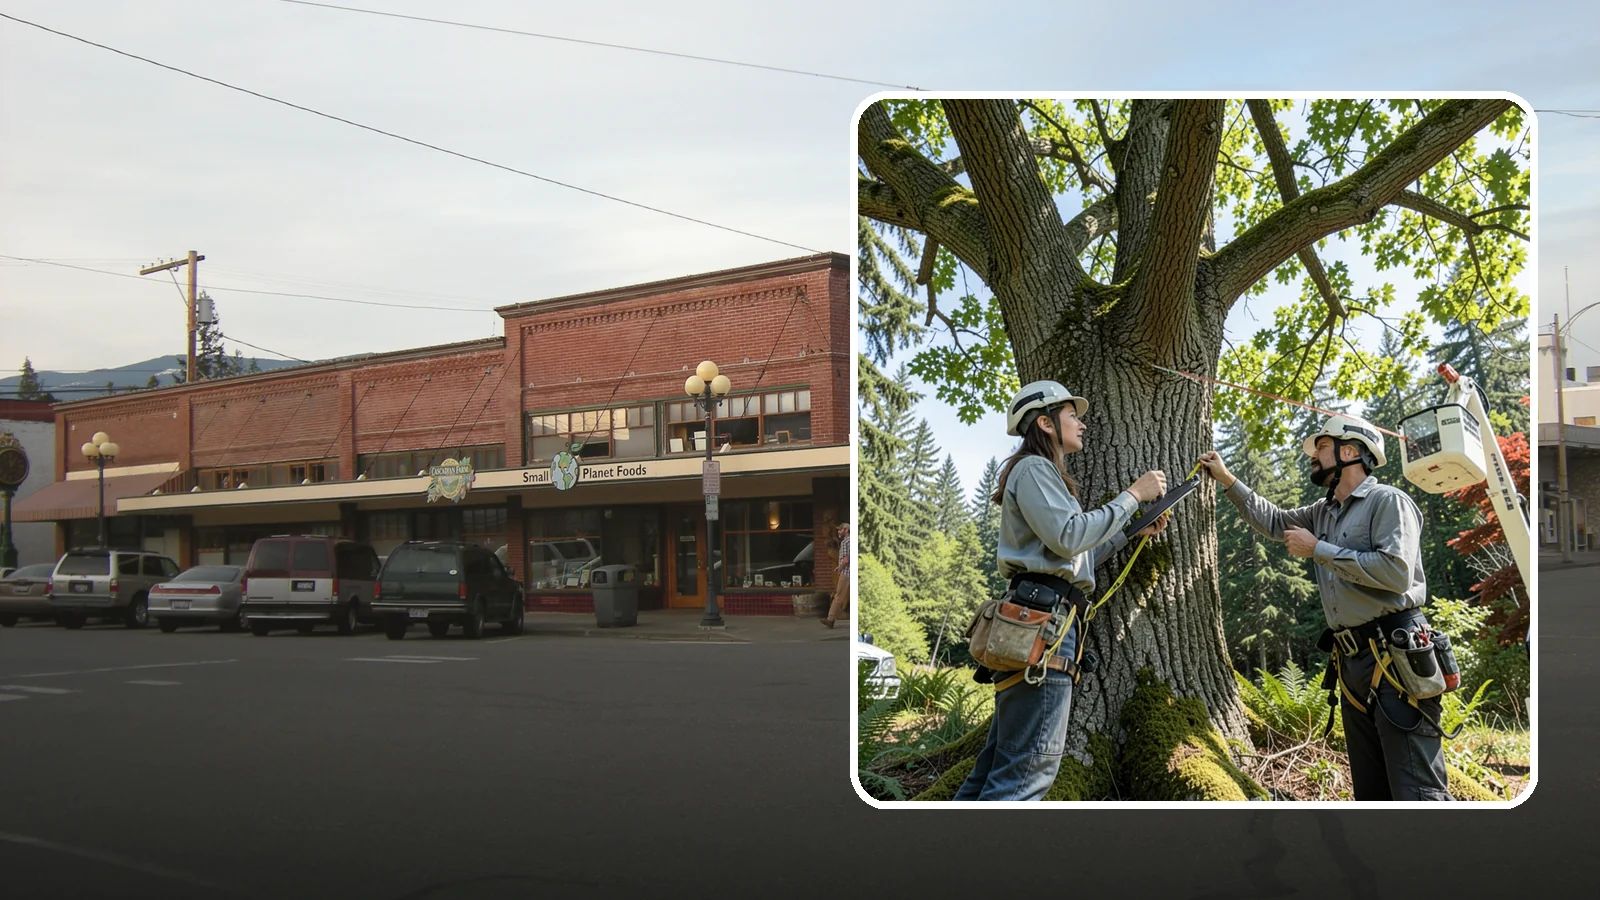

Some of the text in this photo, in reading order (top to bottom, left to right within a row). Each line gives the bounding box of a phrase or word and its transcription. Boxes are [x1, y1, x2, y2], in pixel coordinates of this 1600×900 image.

[523, 464, 647, 483] Small Planet Foods
